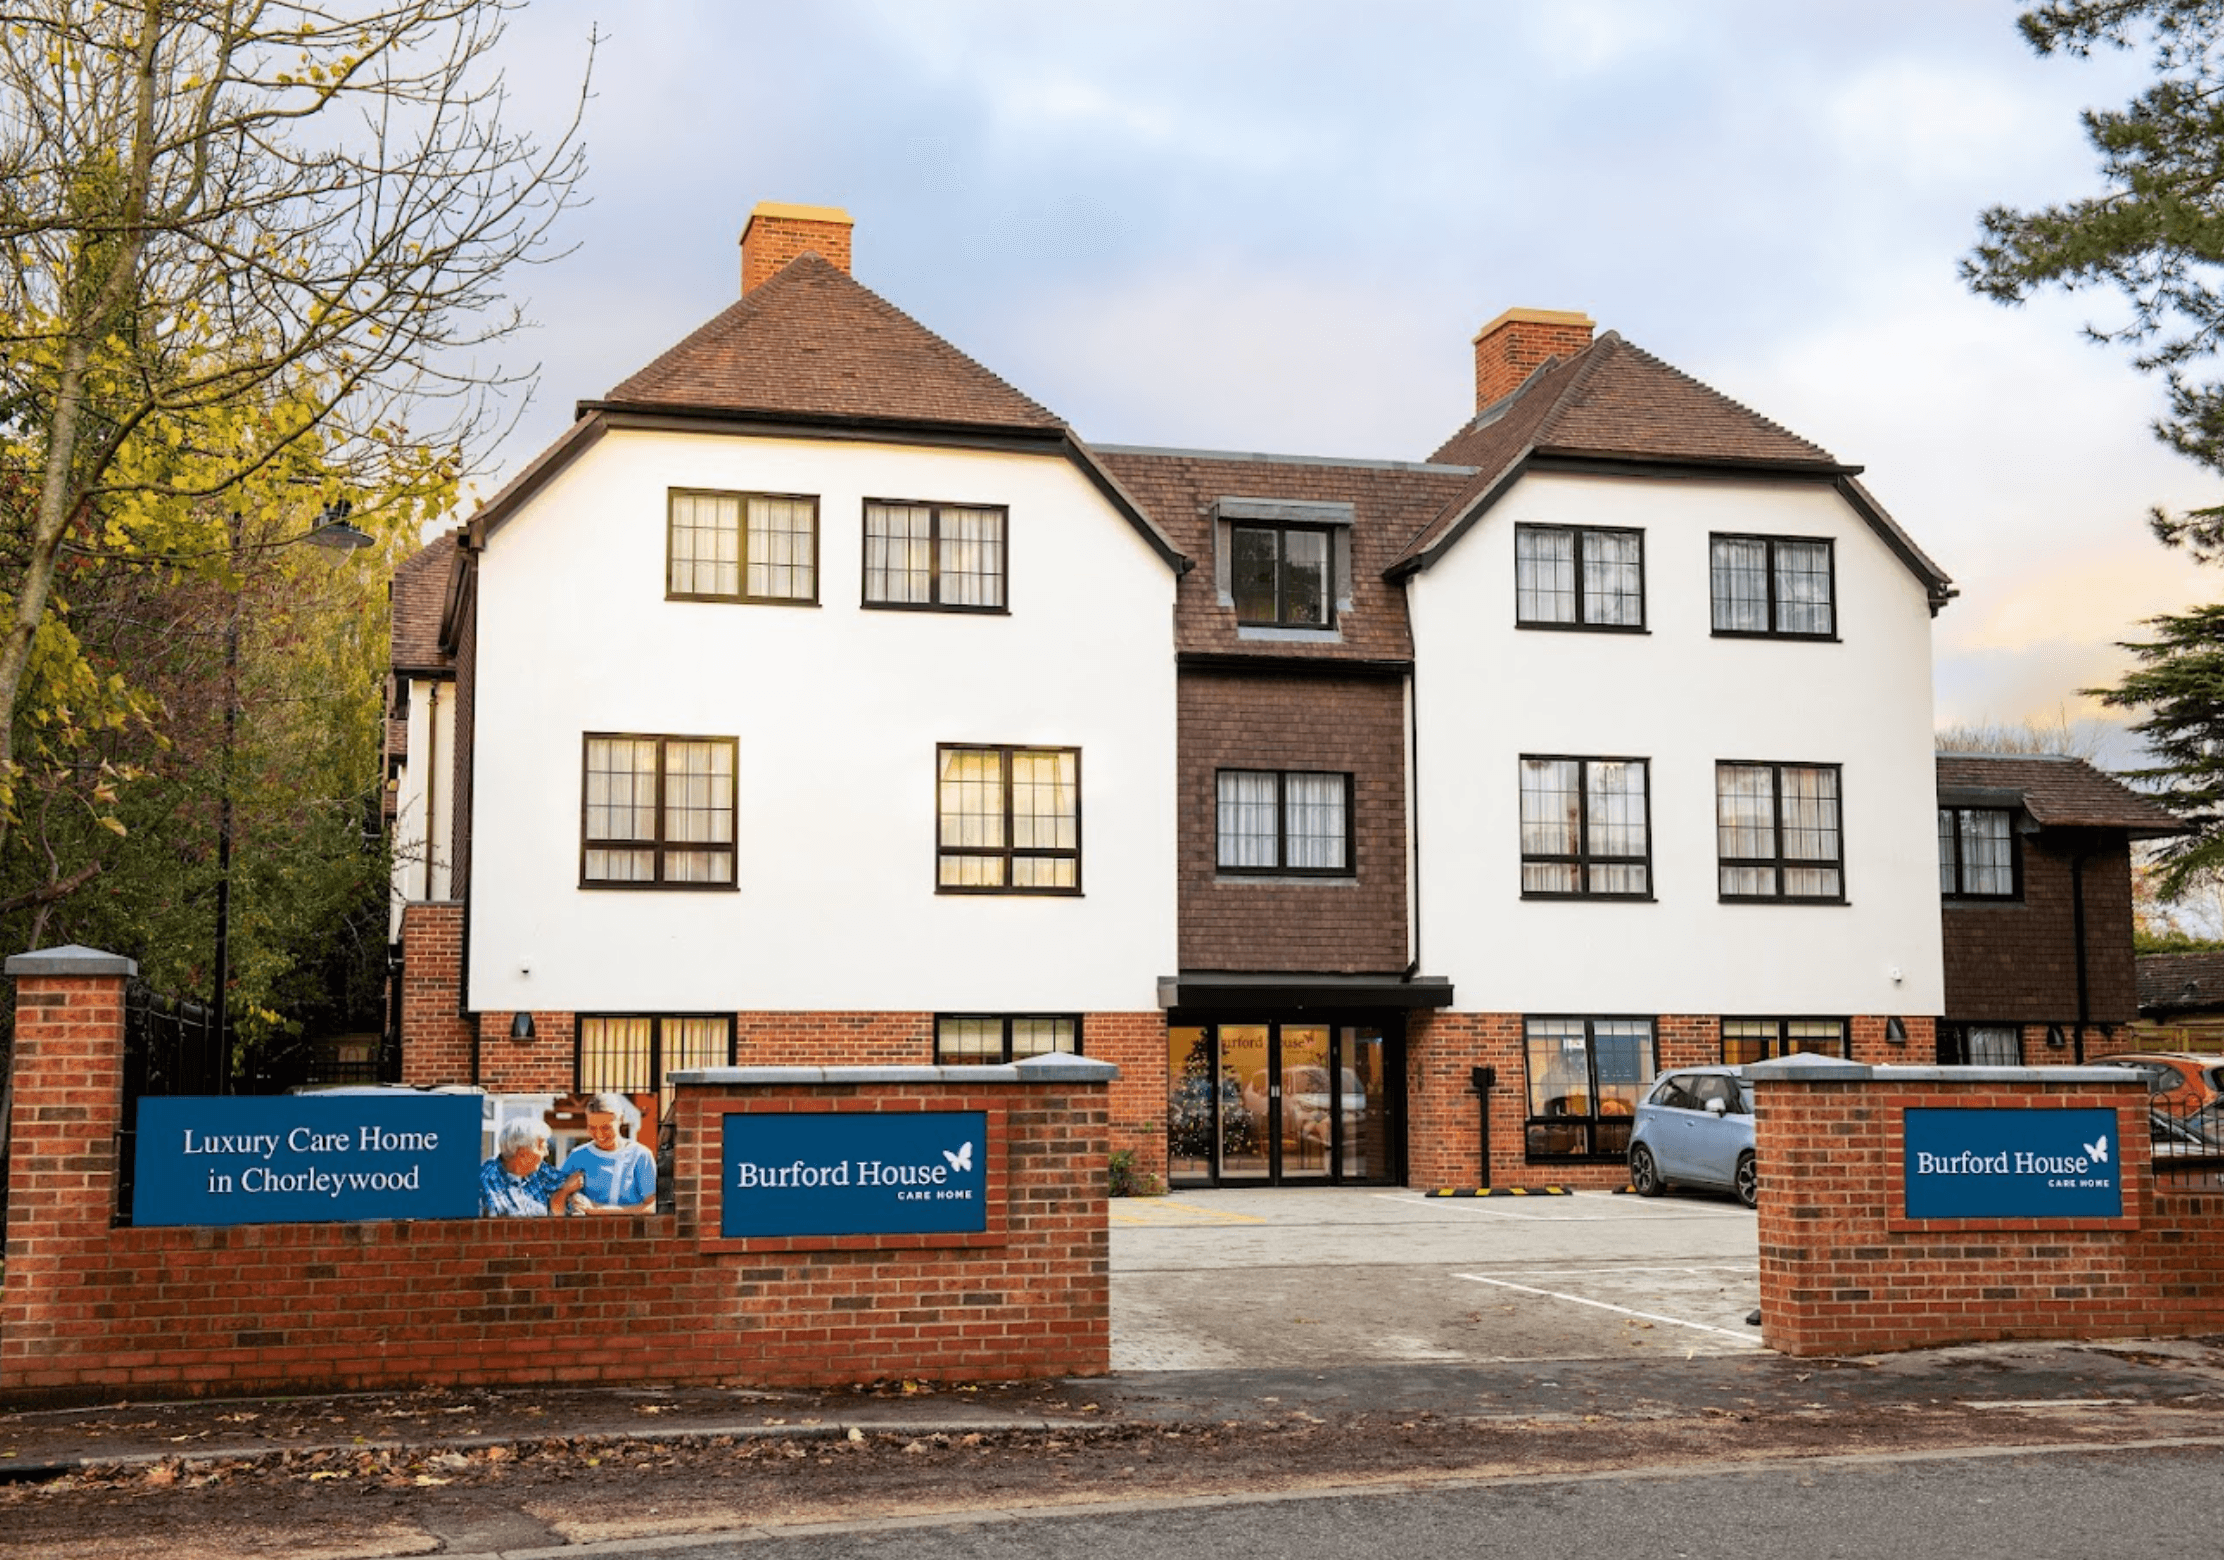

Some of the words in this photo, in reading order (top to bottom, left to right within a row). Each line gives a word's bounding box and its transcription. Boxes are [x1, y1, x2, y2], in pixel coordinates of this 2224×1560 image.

[184, 1129, 280, 1160] Luxury
[288, 1127, 350, 1152] Care
[359, 1126, 438, 1151] Home
[738, 1160, 850, 1188] Burford
[856, 1161, 947, 1186] House
[1917, 1150, 2009, 1174] Burford
[2014, 1152, 2089, 1174] House
[208, 1168, 232, 1193] in
[241, 1164, 419, 1198] Chorleywood
[2048, 1179, 2076, 1188] CARE
[2079, 1179, 2109, 1188] HOME
[897, 1190, 931, 1200] CARE
[936, 1189, 972, 1200] HOME
